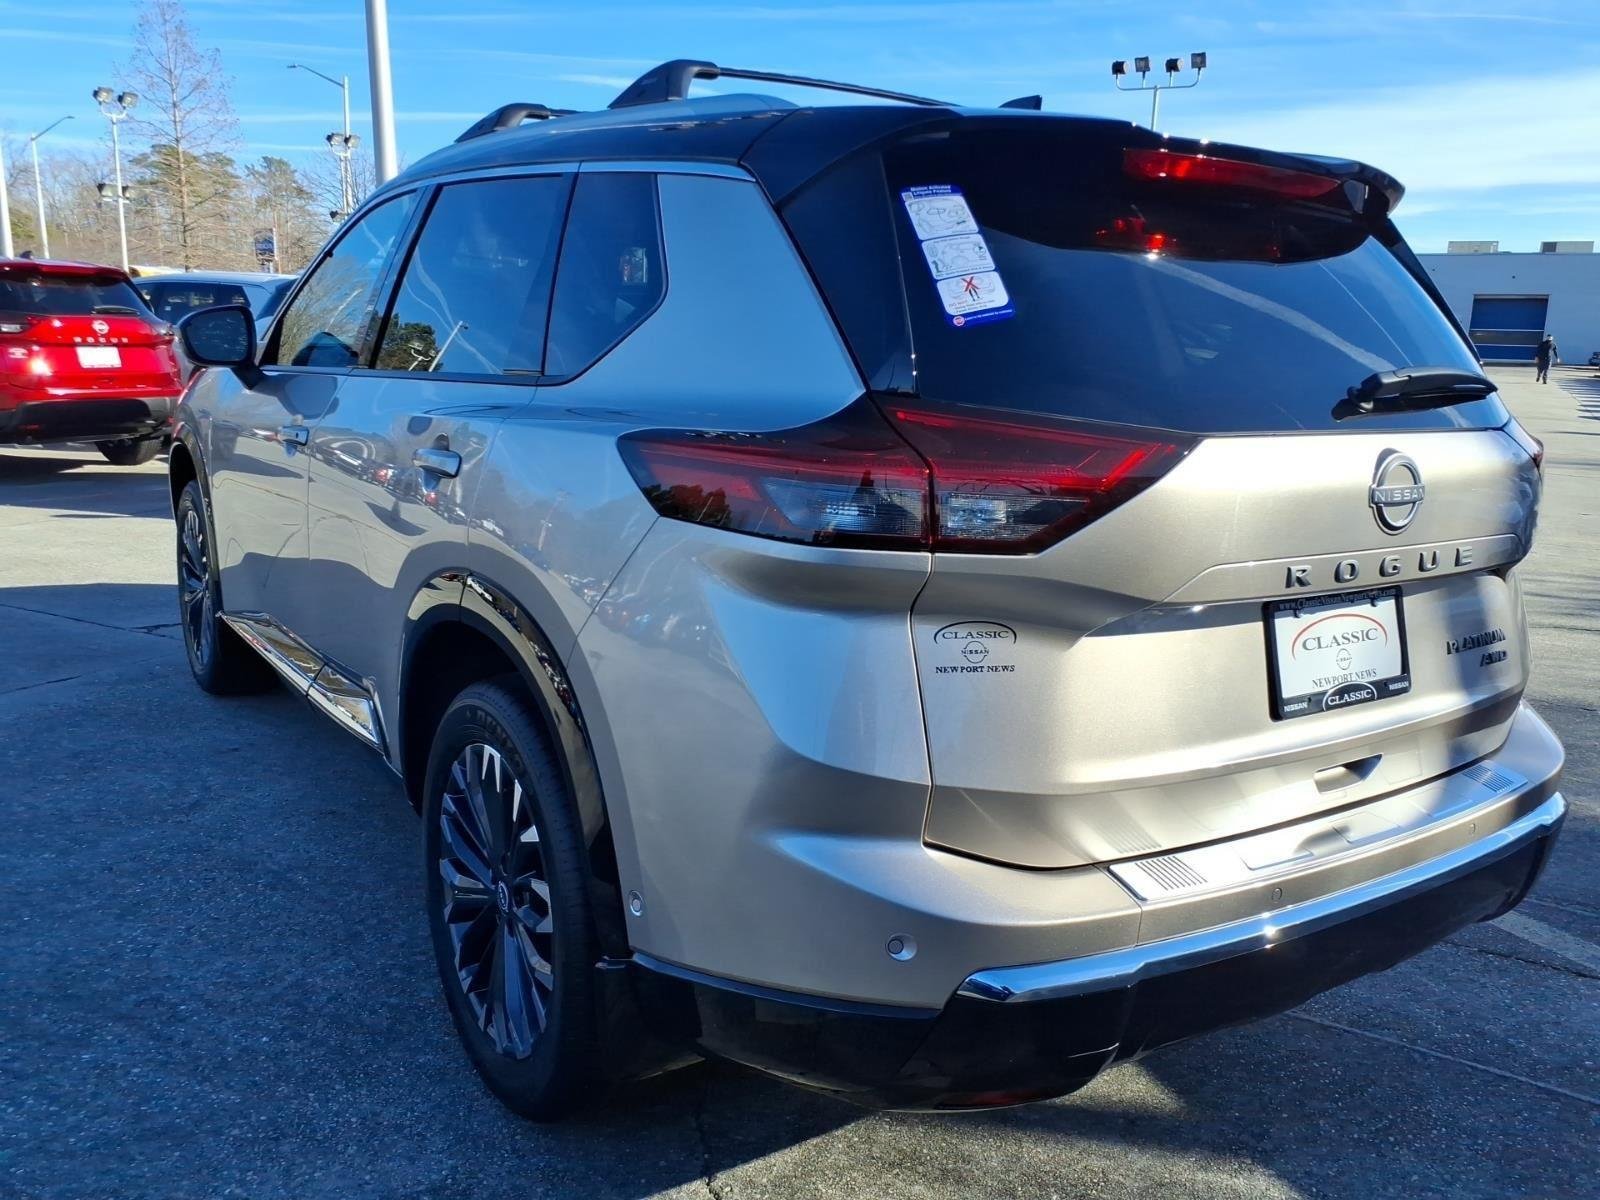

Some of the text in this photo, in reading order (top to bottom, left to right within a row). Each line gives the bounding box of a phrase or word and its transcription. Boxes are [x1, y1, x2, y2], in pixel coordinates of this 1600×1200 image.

[1374, 488, 1424, 502] NISSAN
[1285, 545, 1474, 589] ROGUE
[942, 630, 1010, 640] CLASSIC
[1302, 627, 1379, 651] CLASSIC
[961, 648, 990, 656] NISSAN
[935, 664, 1016, 674] NEWPORT NEWS
[1312, 667, 1378, 689] NEWPORT NEWS
[1388, 681, 1410, 691] NISSAN
[1327, 689, 1372, 706] CLASSIC
[1283, 701, 1309, 713] NISSAN
